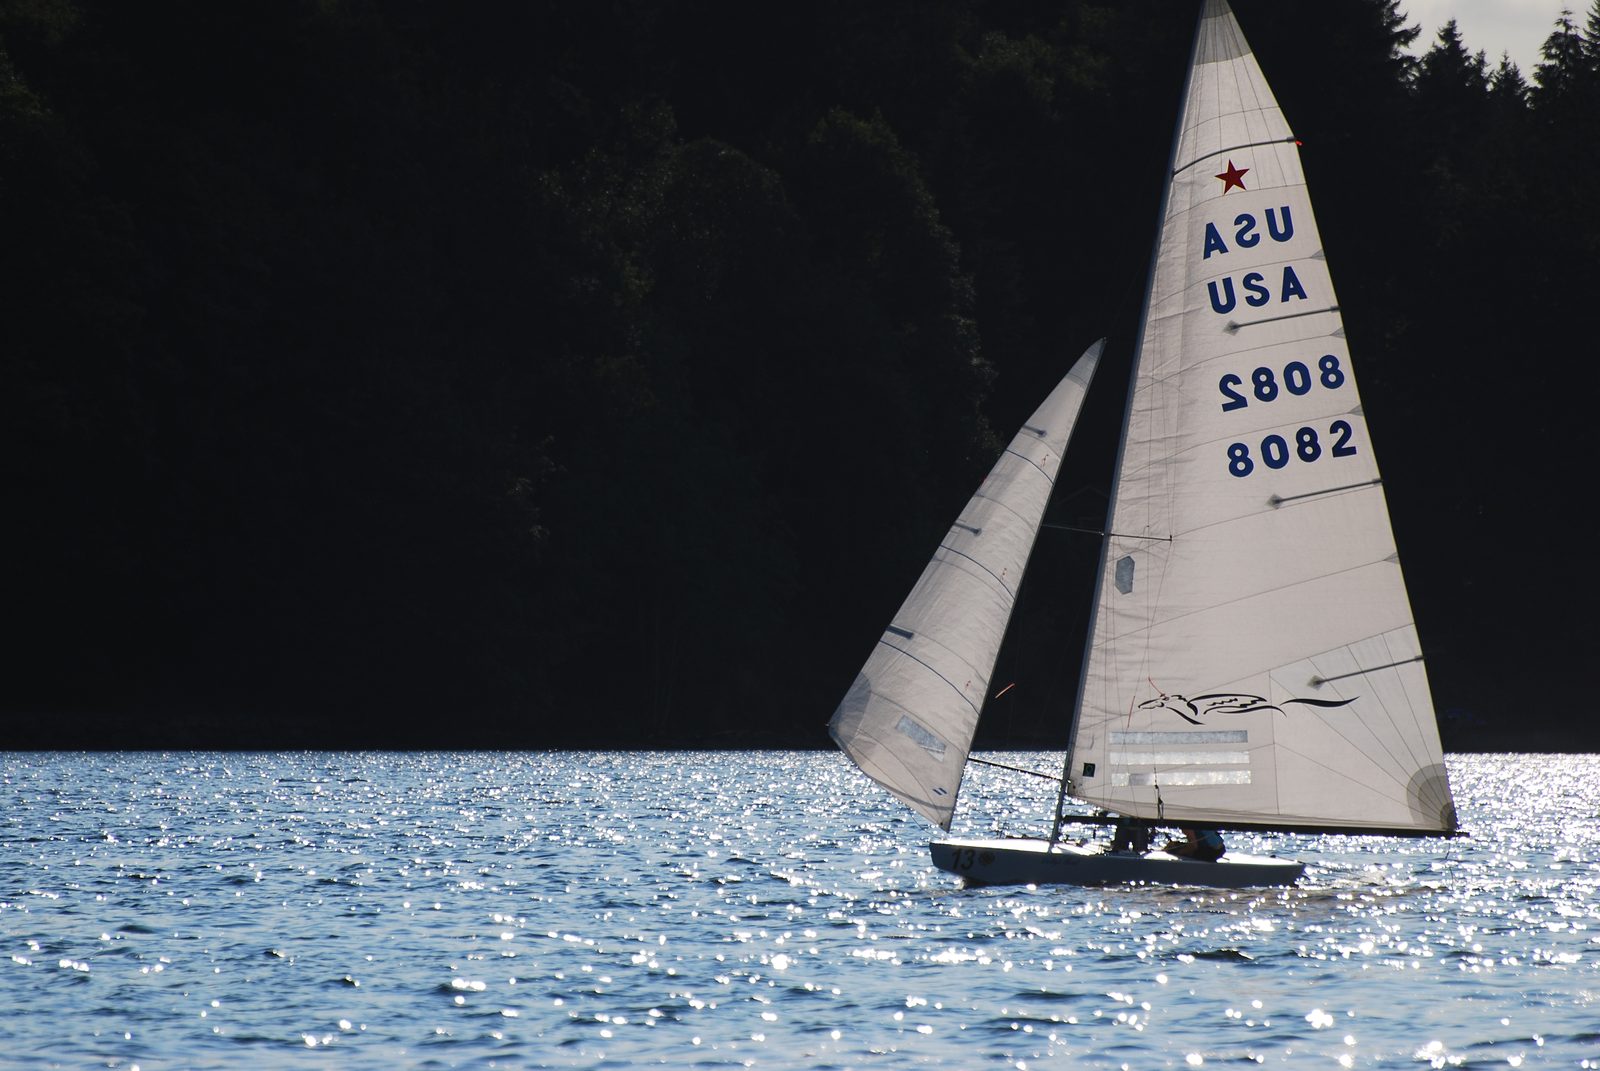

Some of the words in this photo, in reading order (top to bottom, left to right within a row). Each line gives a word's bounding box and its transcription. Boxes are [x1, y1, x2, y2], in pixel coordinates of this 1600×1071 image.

[1207, 266, 1307, 314] USA
[1227, 420, 1356, 477] 8082
[951, 848, 976, 871] 13
